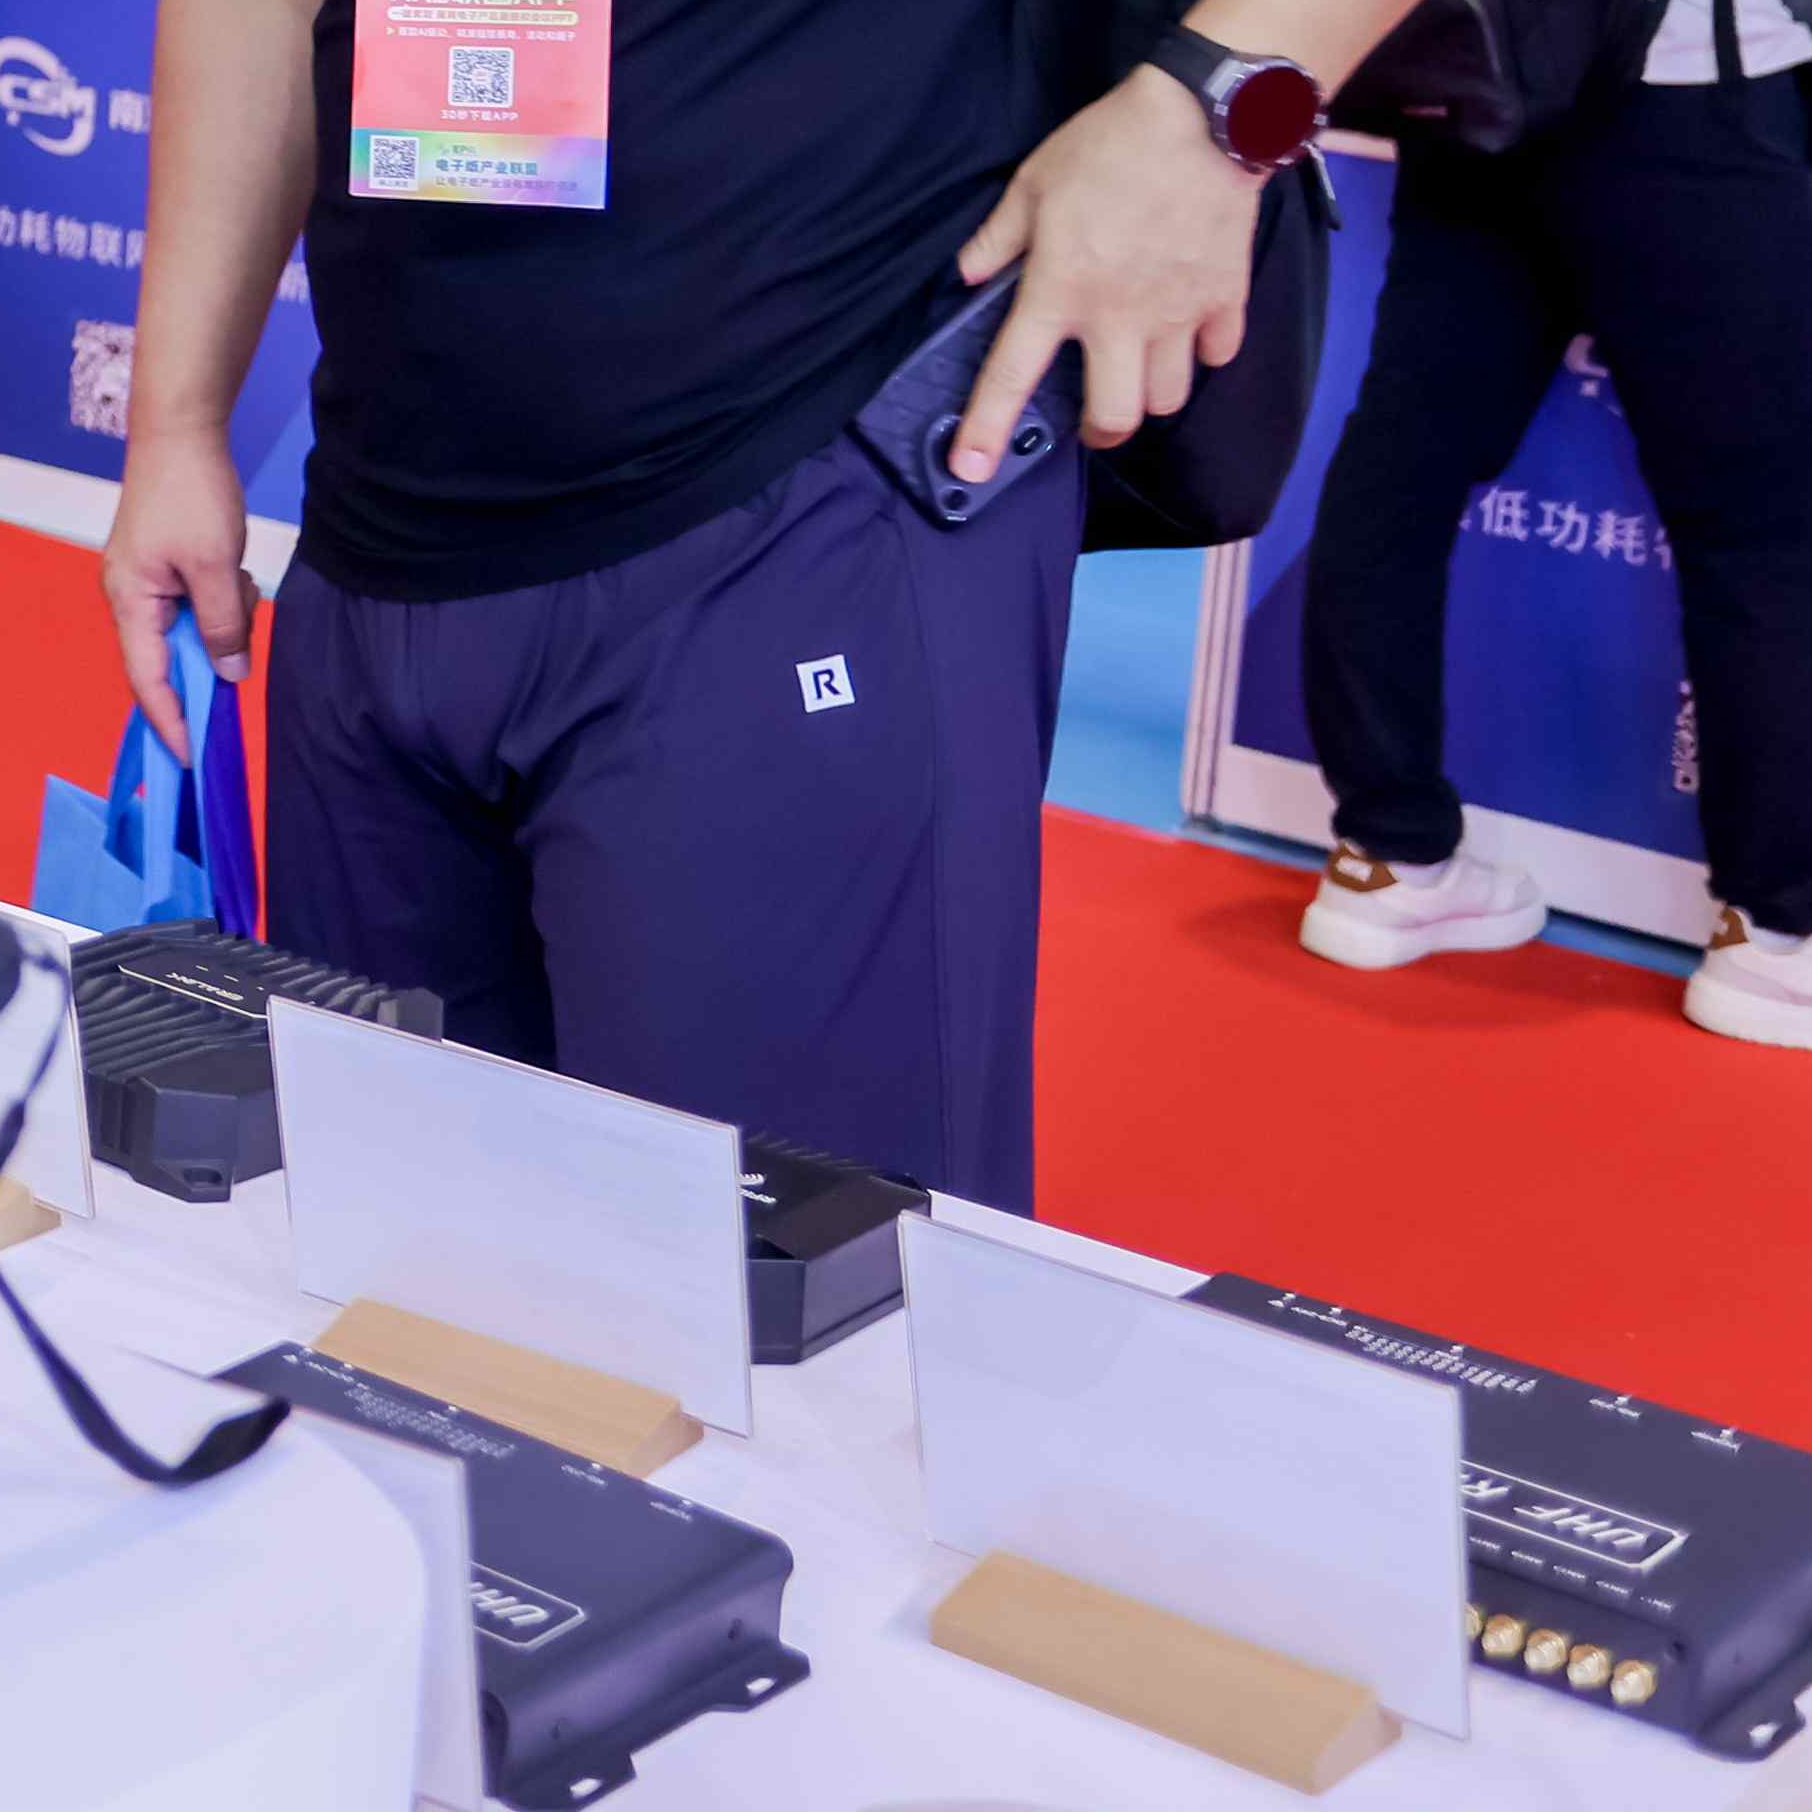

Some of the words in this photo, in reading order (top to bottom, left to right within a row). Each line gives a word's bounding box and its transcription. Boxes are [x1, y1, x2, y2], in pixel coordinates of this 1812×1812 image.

[1459, 486, 1676, 570] 低功耗
[813, 668, 842, 700] R
[1512, 1503, 1648, 1550] UHF
[470, 1580, 550, 1628] UH
